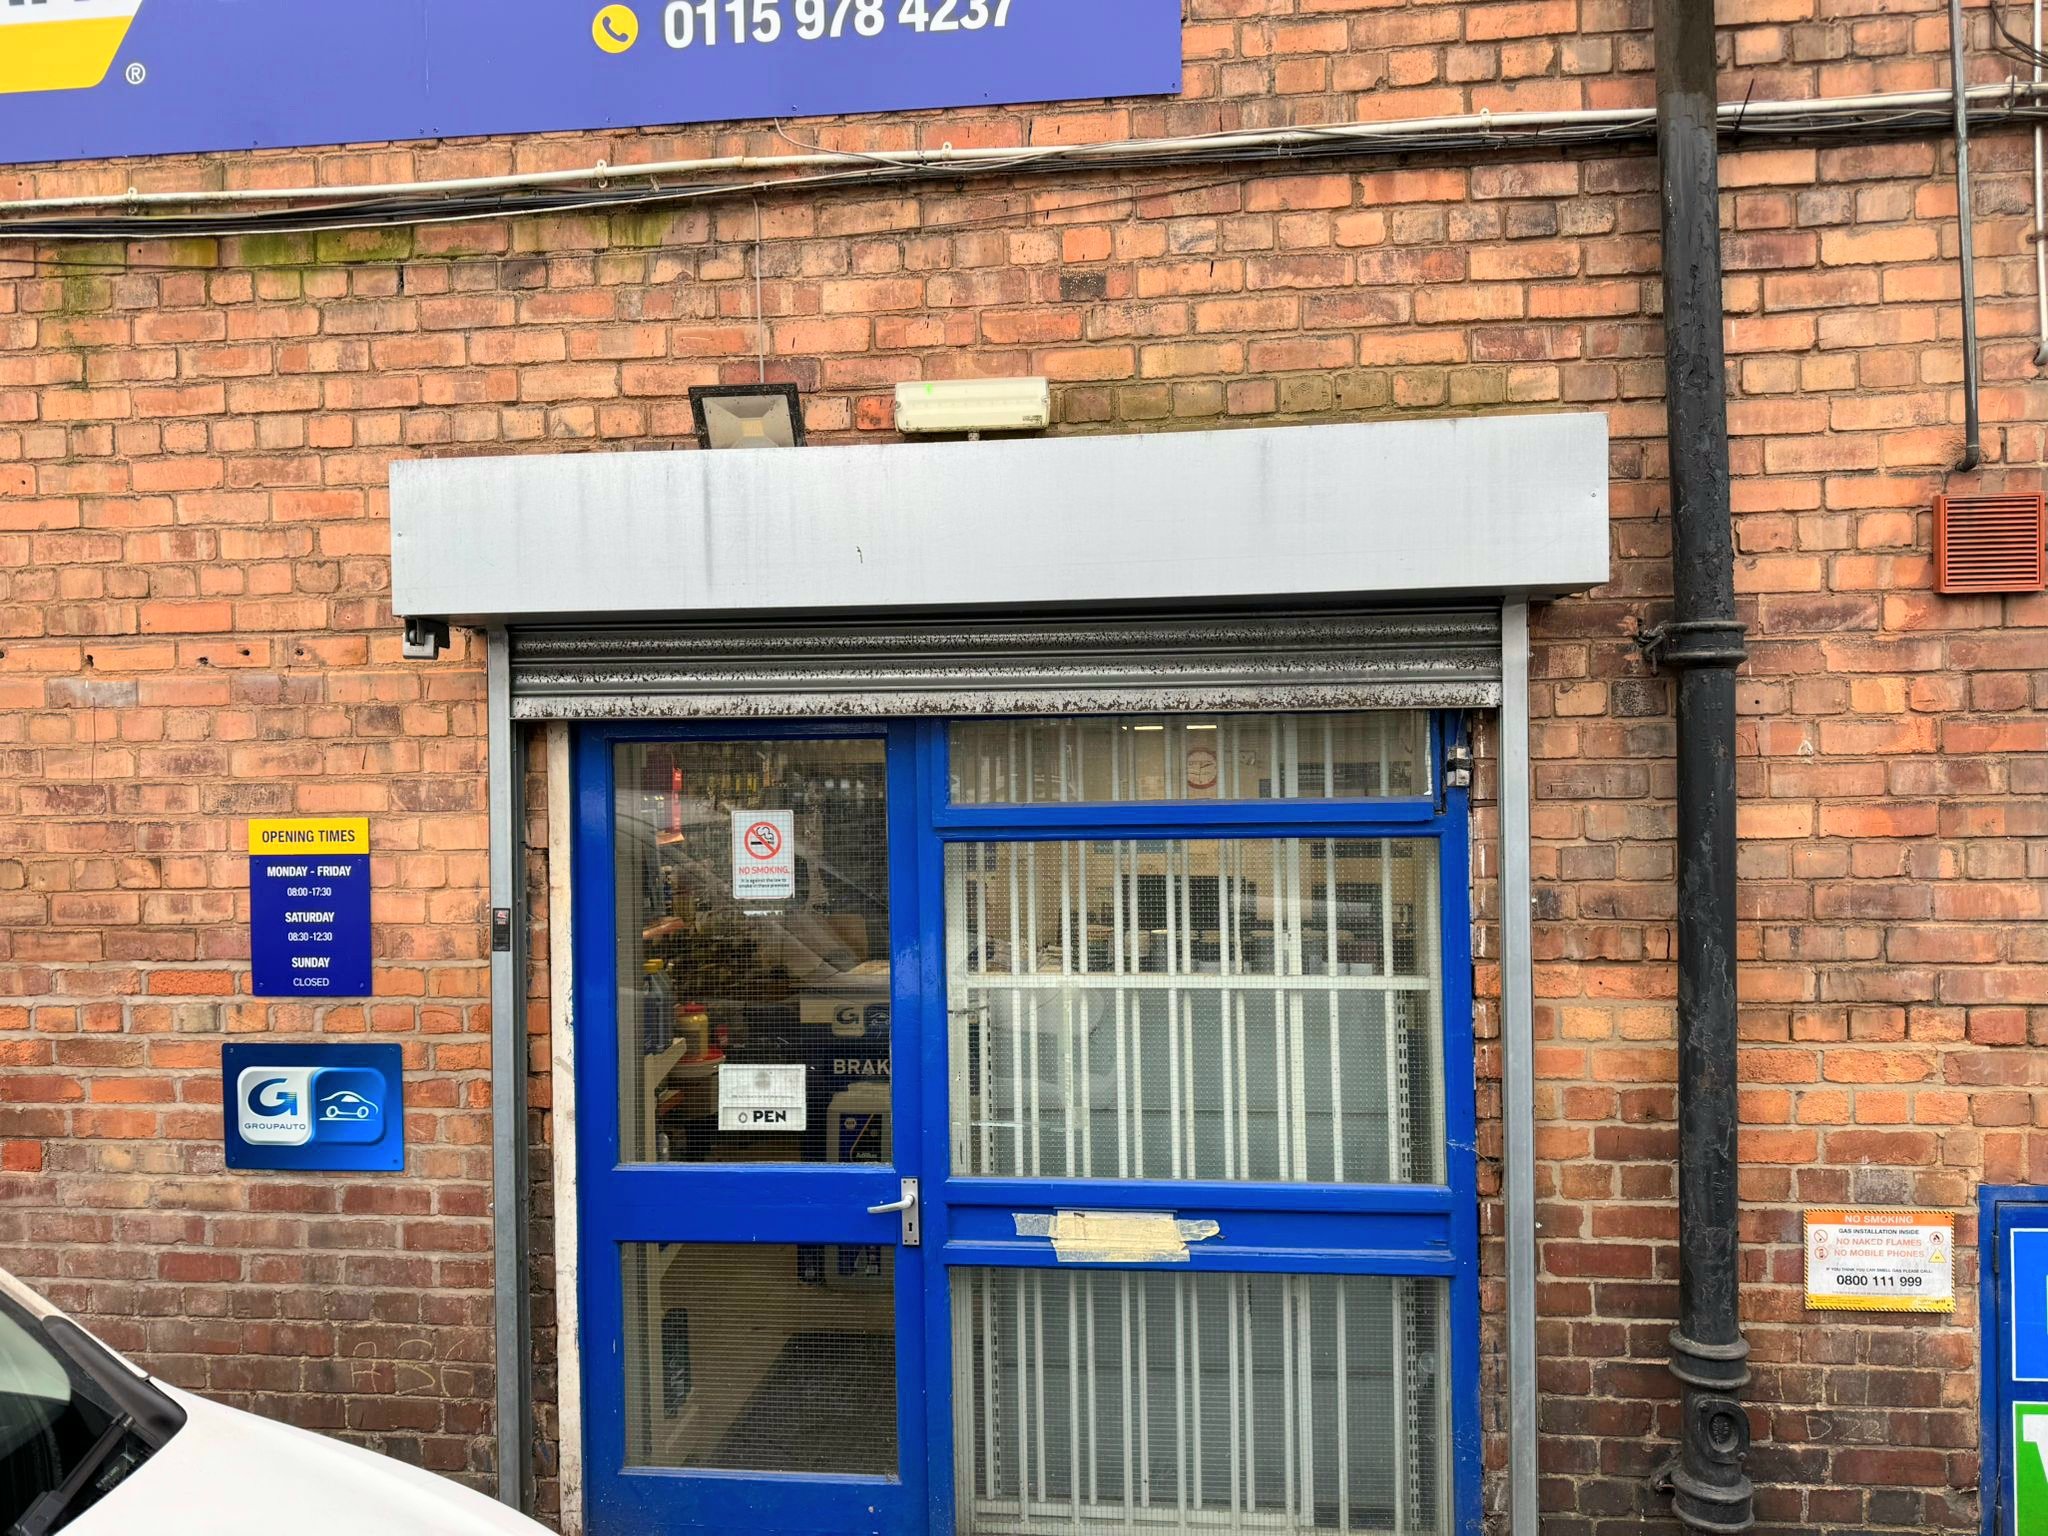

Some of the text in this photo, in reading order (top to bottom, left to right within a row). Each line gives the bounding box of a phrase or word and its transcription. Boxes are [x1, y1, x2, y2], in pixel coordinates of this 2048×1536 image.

[664, 0, 781, 48] 0115
[795, 0, 885, 39] 978
[262, 829, 355, 843] OPENING TIMES
[267, 866, 308, 877] MONDAY
[317, 866, 352, 876] FRIDAY
[739, 866, 750, 874] NO
[285, 912, 335, 922] SATURDAY
[291, 957, 330, 967] SUNDAY
[293, 978, 330, 987] CLOSED
[1845, 1215, 1914, 1224] NO SMOKING
[1836, 1238, 1922, 1247] NO NAKED FLAMES
[1834, 1249, 1847, 1257] NO
[1850, 1249, 1884, 1257] MOBILE
[1887, 1249, 1925, 1258] PHONES
[1836, 1275, 1922, 1287] 0800 111 999
